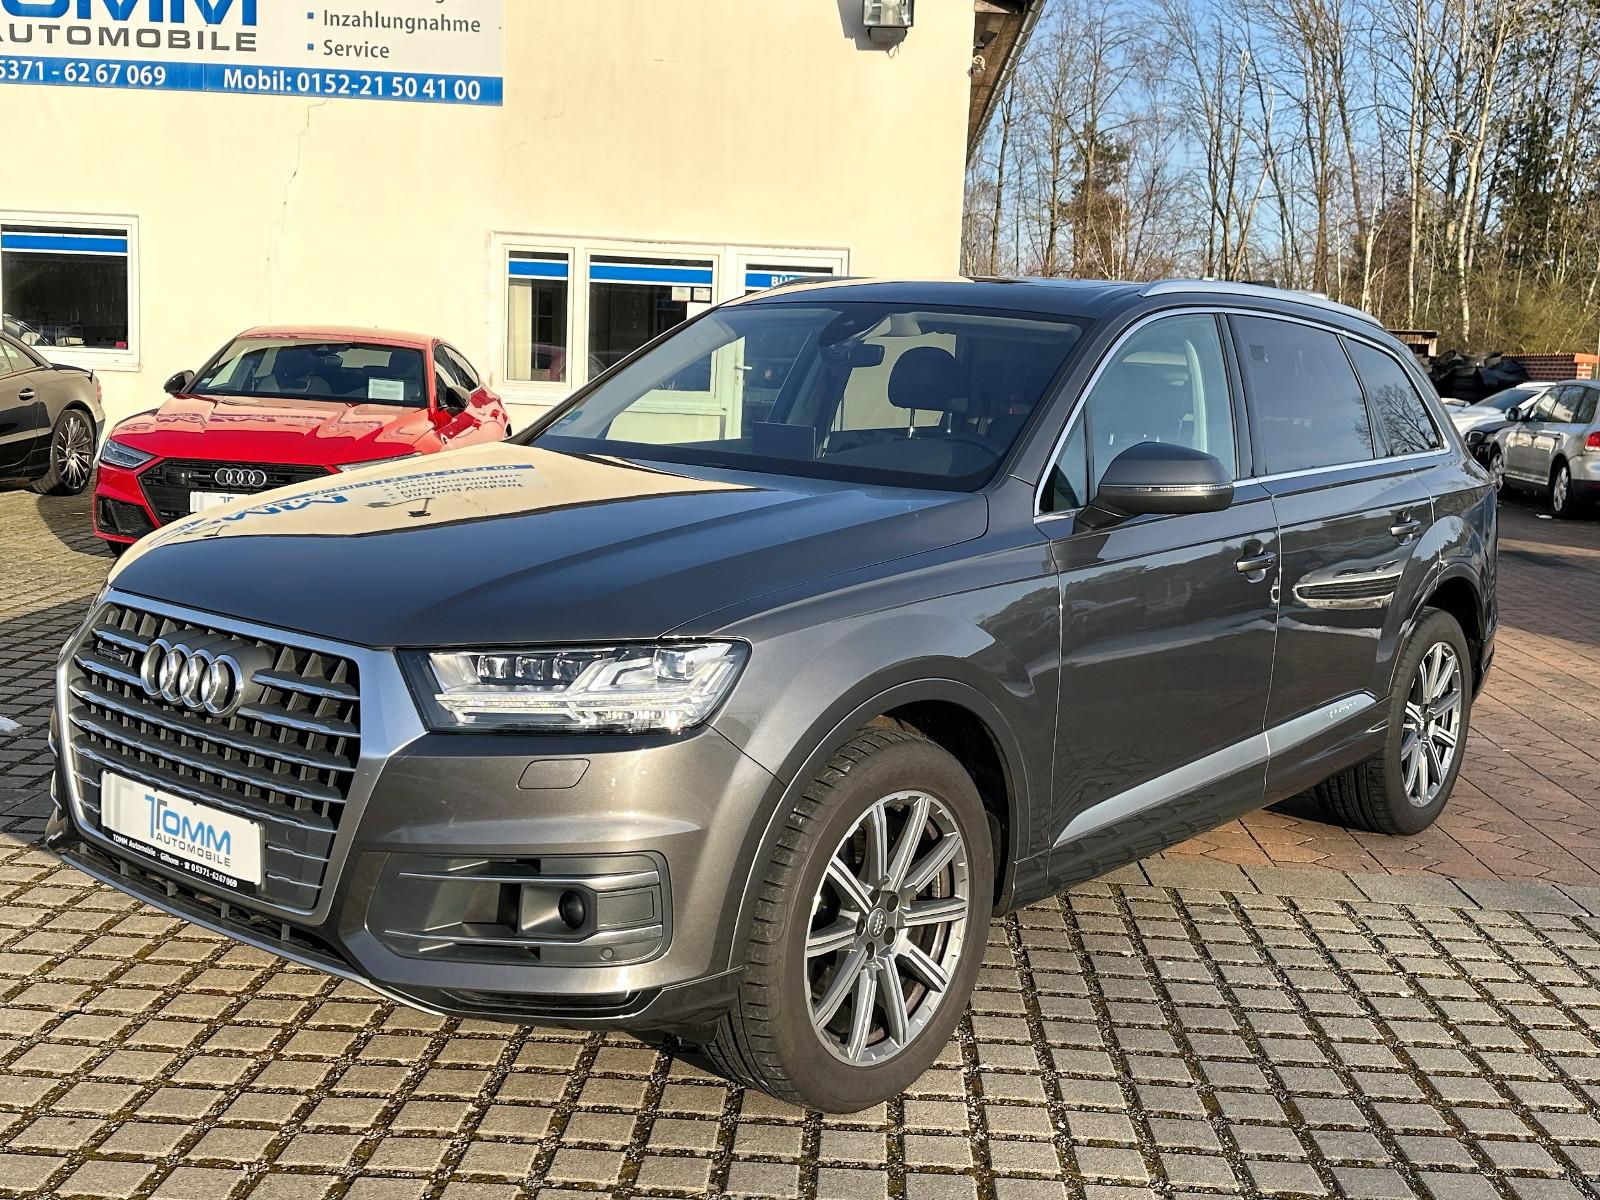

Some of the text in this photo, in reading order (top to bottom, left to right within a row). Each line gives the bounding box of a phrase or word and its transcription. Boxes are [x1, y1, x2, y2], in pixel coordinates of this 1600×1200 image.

[323, 9, 481, 35] Inzahlungnahme
[0, 23, 257, 52] UTOMOBILE
[323, 39, 390, 59] Service
[64, 62, 90, 83] 62
[95, 63, 121, 84] 67
[126, 65, 166, 86] 069
[223, 68, 292, 92] Mobil:
[296, 72, 384, 95] 0152-21
[391, 77, 418, 97] 50
[422, 78, 447, 99] 41
[453, 80, 481, 100] 00
[144, 795, 231, 855] TOMM
[113, 833, 128, 846] TOMM
[129, 840, 156, 857] Automobile
[156, 832, 231, 868] AUTOMOBILE
